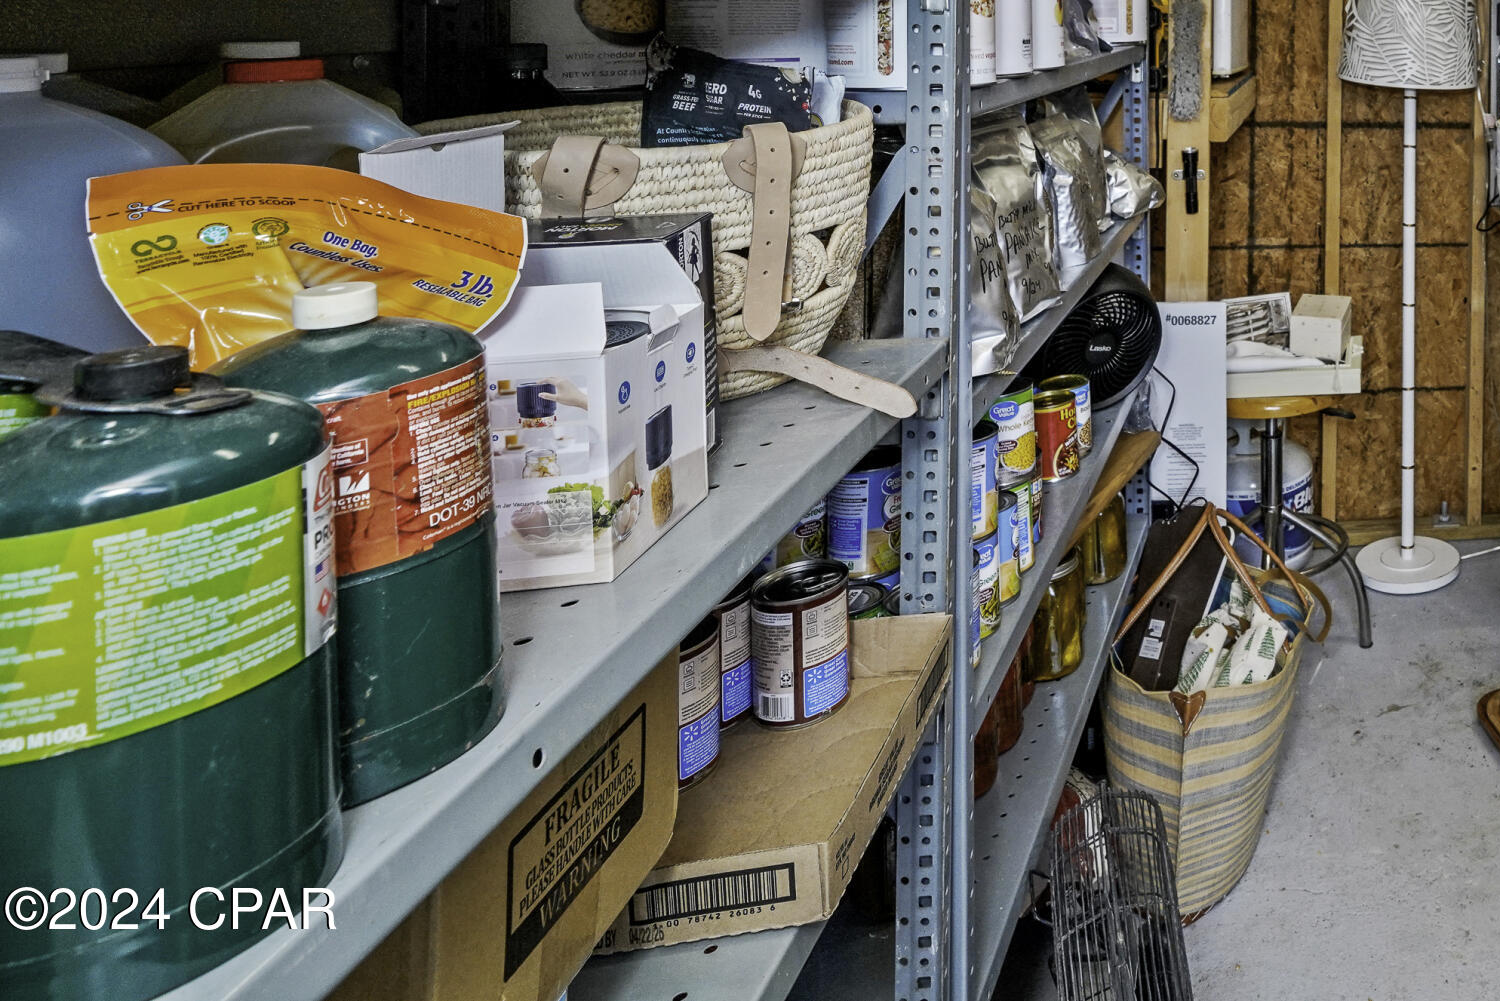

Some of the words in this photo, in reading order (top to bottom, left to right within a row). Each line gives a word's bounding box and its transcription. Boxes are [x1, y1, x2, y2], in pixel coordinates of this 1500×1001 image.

[565, 51, 595, 60] white
[597, 51, 637, 59] cheddar
[672, 100, 697, 112] BEEF
[737, 102, 772, 114] PROTEIN
[177, 204, 200, 213] CUT
[205, 201, 236, 209] HERE
[240, 199, 256, 207] TO
[258, 198, 297, 207] SCOOP
[322, 230, 350, 248] One
[350, 238, 379, 258] Bag.
[289, 241, 351, 264] Countless
[351, 258, 385, 273] Uses.
[412, 278, 469, 305] RESEALABLE
[466, 293, 487, 308] BAG
[450, 269, 474, 290] 3
[468, 274, 495, 298] lb.
[1165, 313, 1218, 326] #0068827
[1089, 344, 1112, 352] Lasko
[992, 405, 1017, 417] Great
[429, 496, 476, 527] DOT-39
[543, 743, 621, 848] FRAGILE
[525, 846, 555, 891] GLASS
[555, 809, 592, 856] BOTTLE
[590, 758, 634, 821] PRODUCTS
[518, 870, 555, 919] PLEASE
[555, 826, 593, 878] HANDLE
[592, 796, 617, 836] WITH
[616, 772, 637, 806] CARE
[538, 815, 622, 930] WARNING
[687, 913, 722, 924] 78742
[729, 907, 763, 917] 26083
[605, 929, 616, 949] BY
[629, 926, 665, 945] 04/22/26
